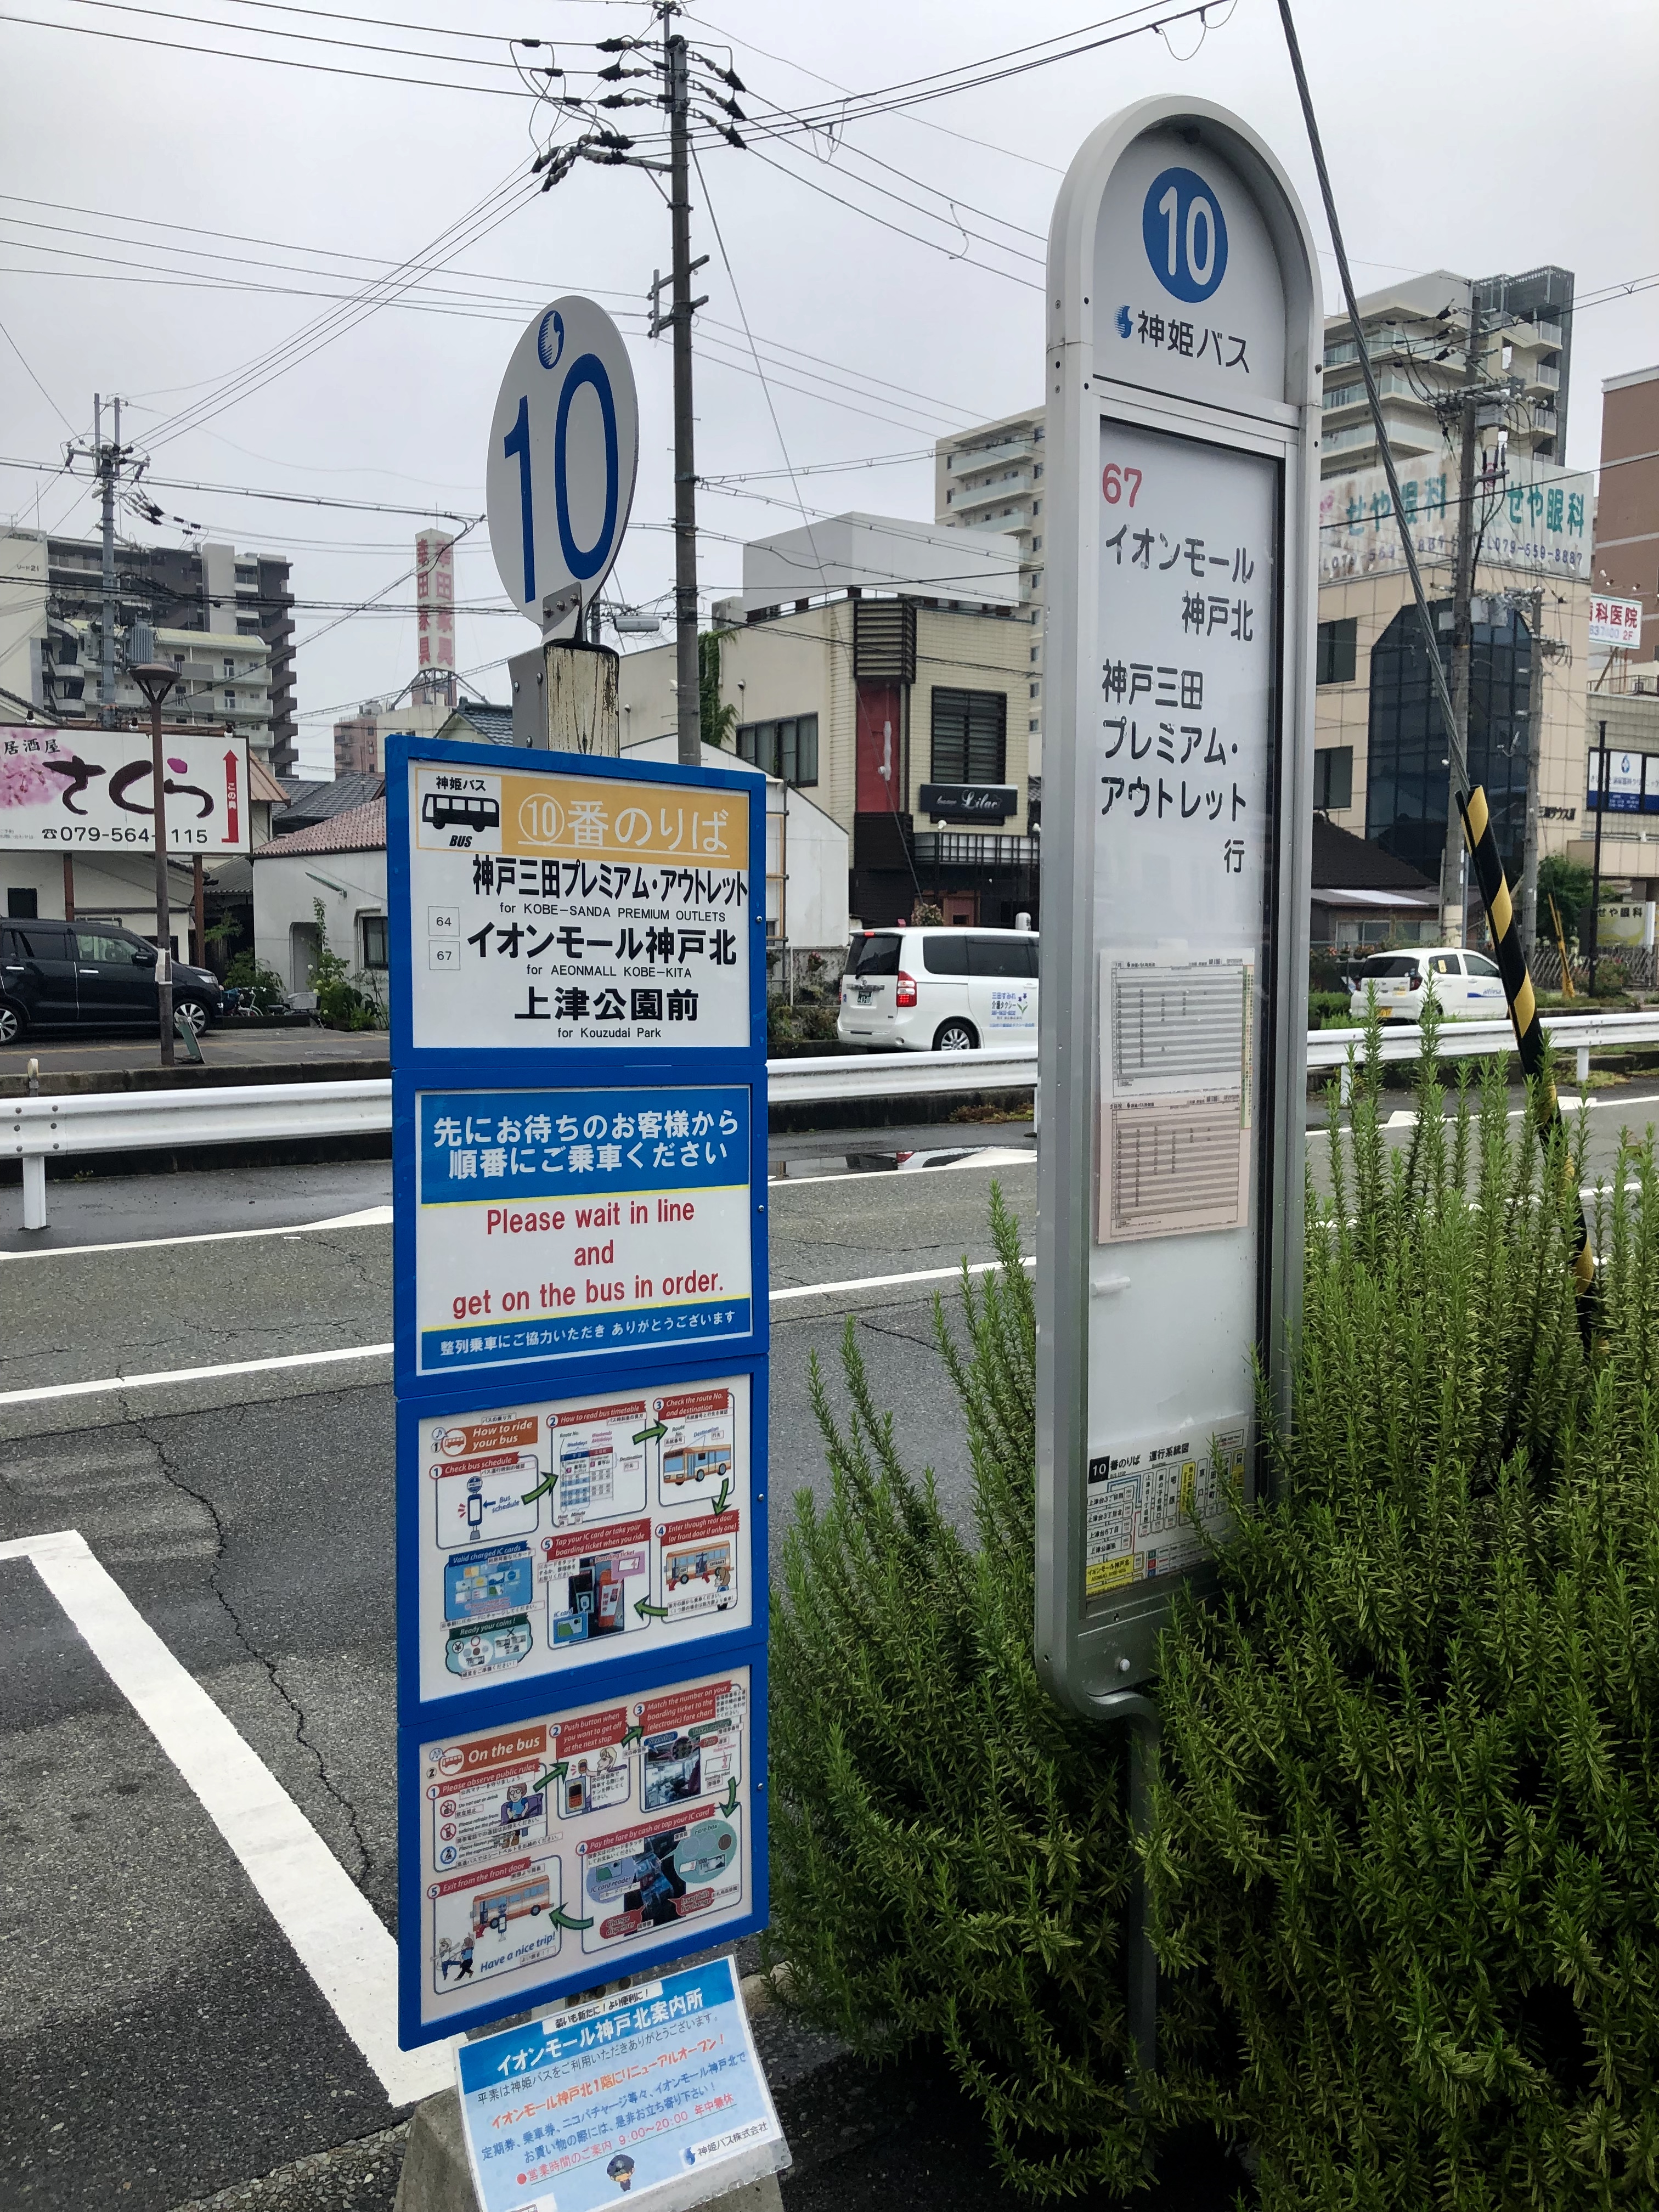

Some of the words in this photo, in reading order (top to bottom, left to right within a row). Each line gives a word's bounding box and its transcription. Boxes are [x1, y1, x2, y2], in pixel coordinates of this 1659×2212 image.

[1159, 186, 1215, 285] 10
[1138, 311, 1250, 373] 神姫バス
[504, 353, 618, 603] 10
[1102, 463, 1142, 507] 67
[1507, 481, 1584, 538] せや眼科
[1105, 524, 1254, 584] イオンモール
[1181, 591, 1254, 641] 神戸北
[1623, 630, 1633, 640] 2F
[1102, 658, 1203, 709] 神戸三田
[4, 738, 61, 755] 居酒屋
[1103, 716, 1238, 765] プレミアム・
[42, 755, 214, 819] さくら
[436, 775, 486, 791] 神姫バス
[1102, 776, 1246, 821] アウトレット
[449, 835, 472, 848] BUS
[1223, 839, 1244, 873] 行
[472, 854, 748, 906] 神戸三田プレミアム・アウトレット
[436, 917, 452, 926] 64
[500, 903, 516, 913] for
[524, 903, 610, 917] KOBE-SANDA
[618, 908, 669, 919] PREMIUM
[676, 910, 725, 922] OUTLETS
[437, 951, 452, 960] 67
[467, 922, 736, 966] イオンモール神戸北
[527, 965, 542, 975] for
[551, 966, 616, 977] AEONMALL
[624, 967, 692, 978] KOBE-KITA
[515, 987, 698, 1021] 上津公園前
[557, 1028, 573, 1037] for
[580, 1028, 630, 1037] Kouzudai
[637, 1028, 661, 1038] Park
[433, 1109, 737, 1148] 先にお待ちのお客様から
[449, 1141, 727, 1180] 順番にご乗車ください
[487, 1208, 565, 1234] Please
[575, 1202, 620, 1228] wait
[630, 1201, 648, 1224] in
[658, 1198, 695, 1222] line
[574, 1240, 614, 1266] and
[453, 1290, 491, 1319] get
[502, 1290, 529, 1311] on
[540, 1283, 575, 1307] the
[586, 1279, 625, 1303] bus
[635, 1275, 653, 1298] in
[662, 1270, 724, 1295] order.
[440, 1325, 605, 1356] 整列乗車にご協力いただき
[612, 1311, 735, 1336] ありがとうございます
[611, 1405, 639, 1415] timetable
[679, 1404, 713, 1414] destination
[472, 1427, 496, 1437] How
[512, 1421, 533, 1431] ride
[693, 1426, 719, 1437] Destination
[472, 1438, 496, 1451] your
[499, 1435, 518, 1444] bus
[444, 1464, 466, 1474] Check
[481, 1457, 512, 1468] schedule
[1110, 1454, 1141, 1470] 番のりば
[1149, 1443, 1189, 1462] 運行系統図
[1093, 1464, 1107, 1476] 10
[684, 1519, 706, 1529] through
[556, 1546, 584, 1556] boarding
[621, 1536, 631, 1544] you
[595, 1553, 619, 1562] Boarding
[561, 1607, 572, 1616] card
[647, 1701, 667, 1711] Match
[680, 1692, 703, 1703] number
[714, 1685, 727, 1695] your
[564, 1723, 579, 1732] Push
[580, 1717, 601, 1728] button
[603, 1713, 619, 1722] when
[647, 1709, 676, 1721] boarding
[678, 1703, 695, 1712] ticket
[564, 1736, 575, 1744] you
[577, 1731, 592, 1739] want
[602, 1726, 612, 1735] get
[469, 1750, 487, 1763] On
[492, 1742, 512, 1756] the
[517, 1737, 540, 1750] bus
[442, 1782, 465, 1793] Please
[467, 1774, 494, 1786] observe
[496, 1768, 517, 1780] public
[519, 1764, 535, 1772] rules
[443, 1882, 457, 1891] Exit
[458, 1877, 475, 1888] from
[477, 1874, 488, 1882] the
[489, 1868, 507, 1878] front
[509, 1862, 526, 1872] door
[598, 1882, 611, 1892] card
[613, 1876, 631, 1887] reader
[607, 1916, 630, 1926] Change
[607, 1922, 635, 1934] dispenser
[480, 1956, 504, 1972] Have
[515, 1943, 534, 1955] nice
[537, 1932, 555, 1946] trip!
[498, 1988, 704, 2076] イオンモール神戸北案内所
[477, 2012, 719, 2103] 平素は神姫バスをご利用いただきありがとうございます。
[481, 2052, 746, 2161] 定期券、乗車券、ニコパチャージ等々、イオンモール神戸北で
[694, 2092, 734, 2115] 年中無休
[523, 2081, 715, 2164] お買い物の際には、是非お立ち寄り下さい！
[697, 2121, 768, 2157] 神姫バス株式会社
